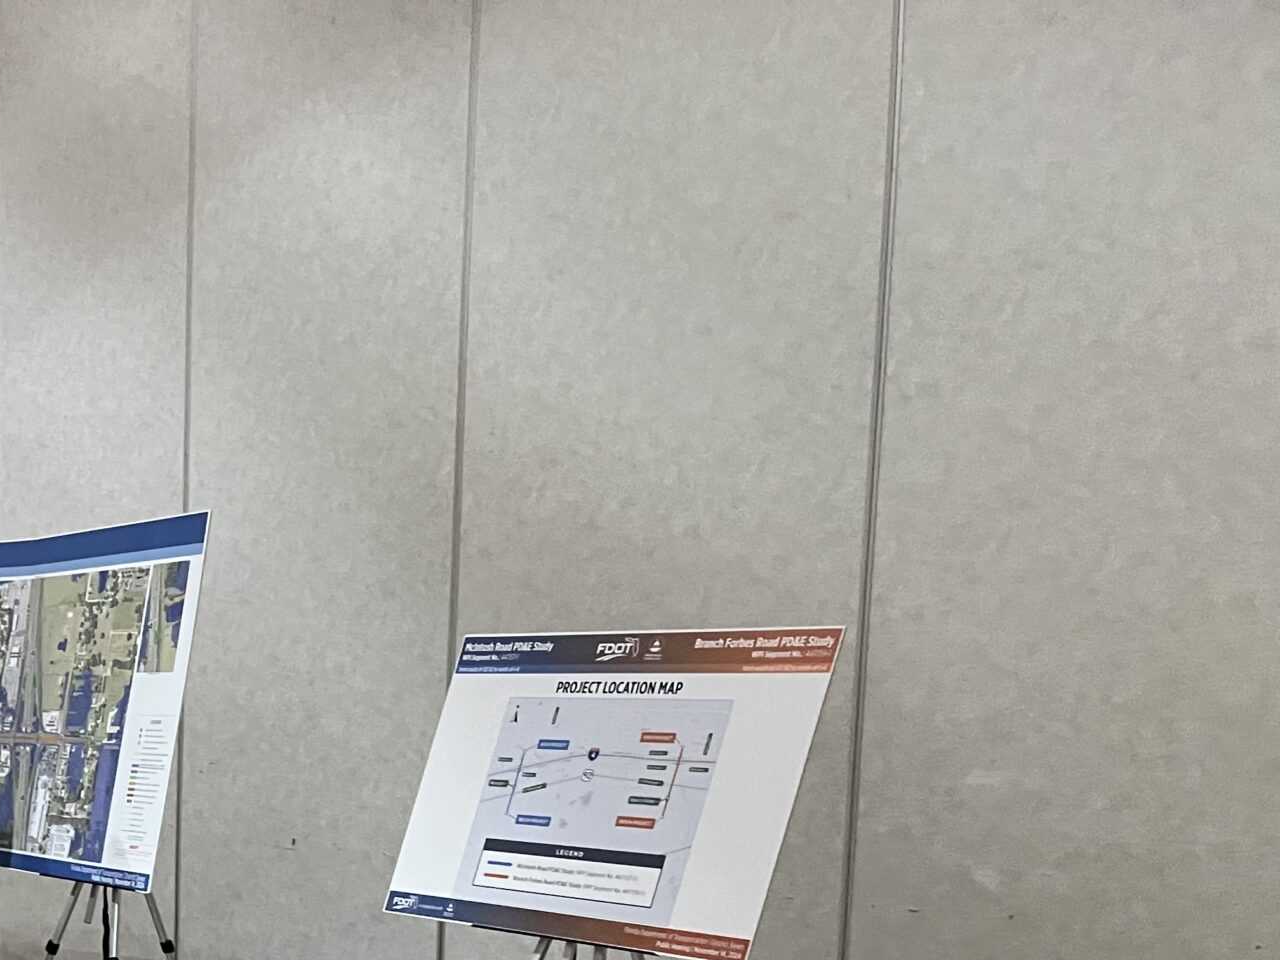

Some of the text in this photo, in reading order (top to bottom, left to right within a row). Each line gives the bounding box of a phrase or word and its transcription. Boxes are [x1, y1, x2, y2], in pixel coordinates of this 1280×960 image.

[494, 642, 513, 652] Road
[532, 641, 554, 652] Study
[596, 642, 634, 655] FDOT
[694, 635, 835, 649] Branch Forbes Road PD&E Study
[555, 681, 684, 695] PROJECT LOCATION MAP
[555, 848, 585, 858] LEGEND
